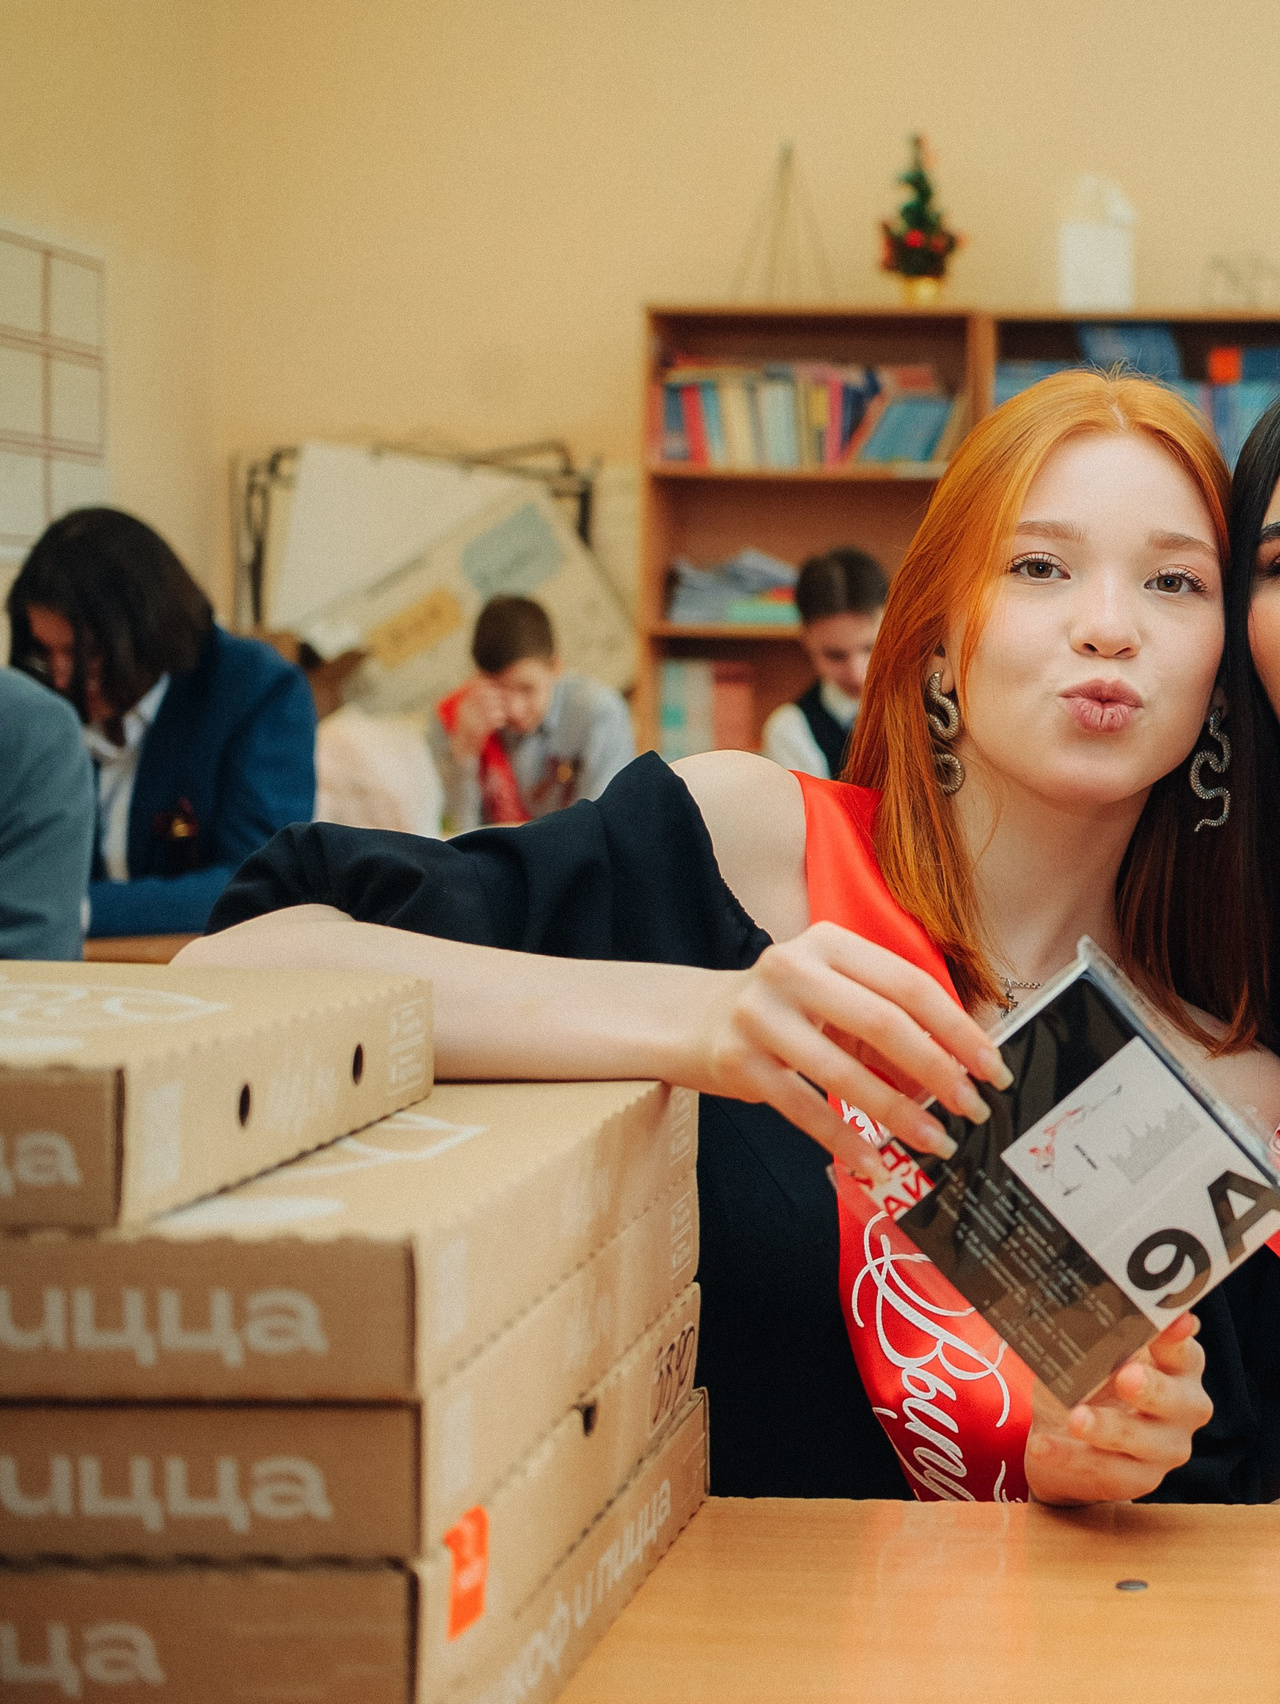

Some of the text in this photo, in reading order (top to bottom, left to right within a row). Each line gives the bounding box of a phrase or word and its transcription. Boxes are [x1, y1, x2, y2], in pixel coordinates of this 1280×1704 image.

[0, 1131, 82, 1196] а
[0, 1287, 329, 1367] ицца
[0, 1455, 333, 1532] ицца
[597, 1477, 671, 1606] пицца
